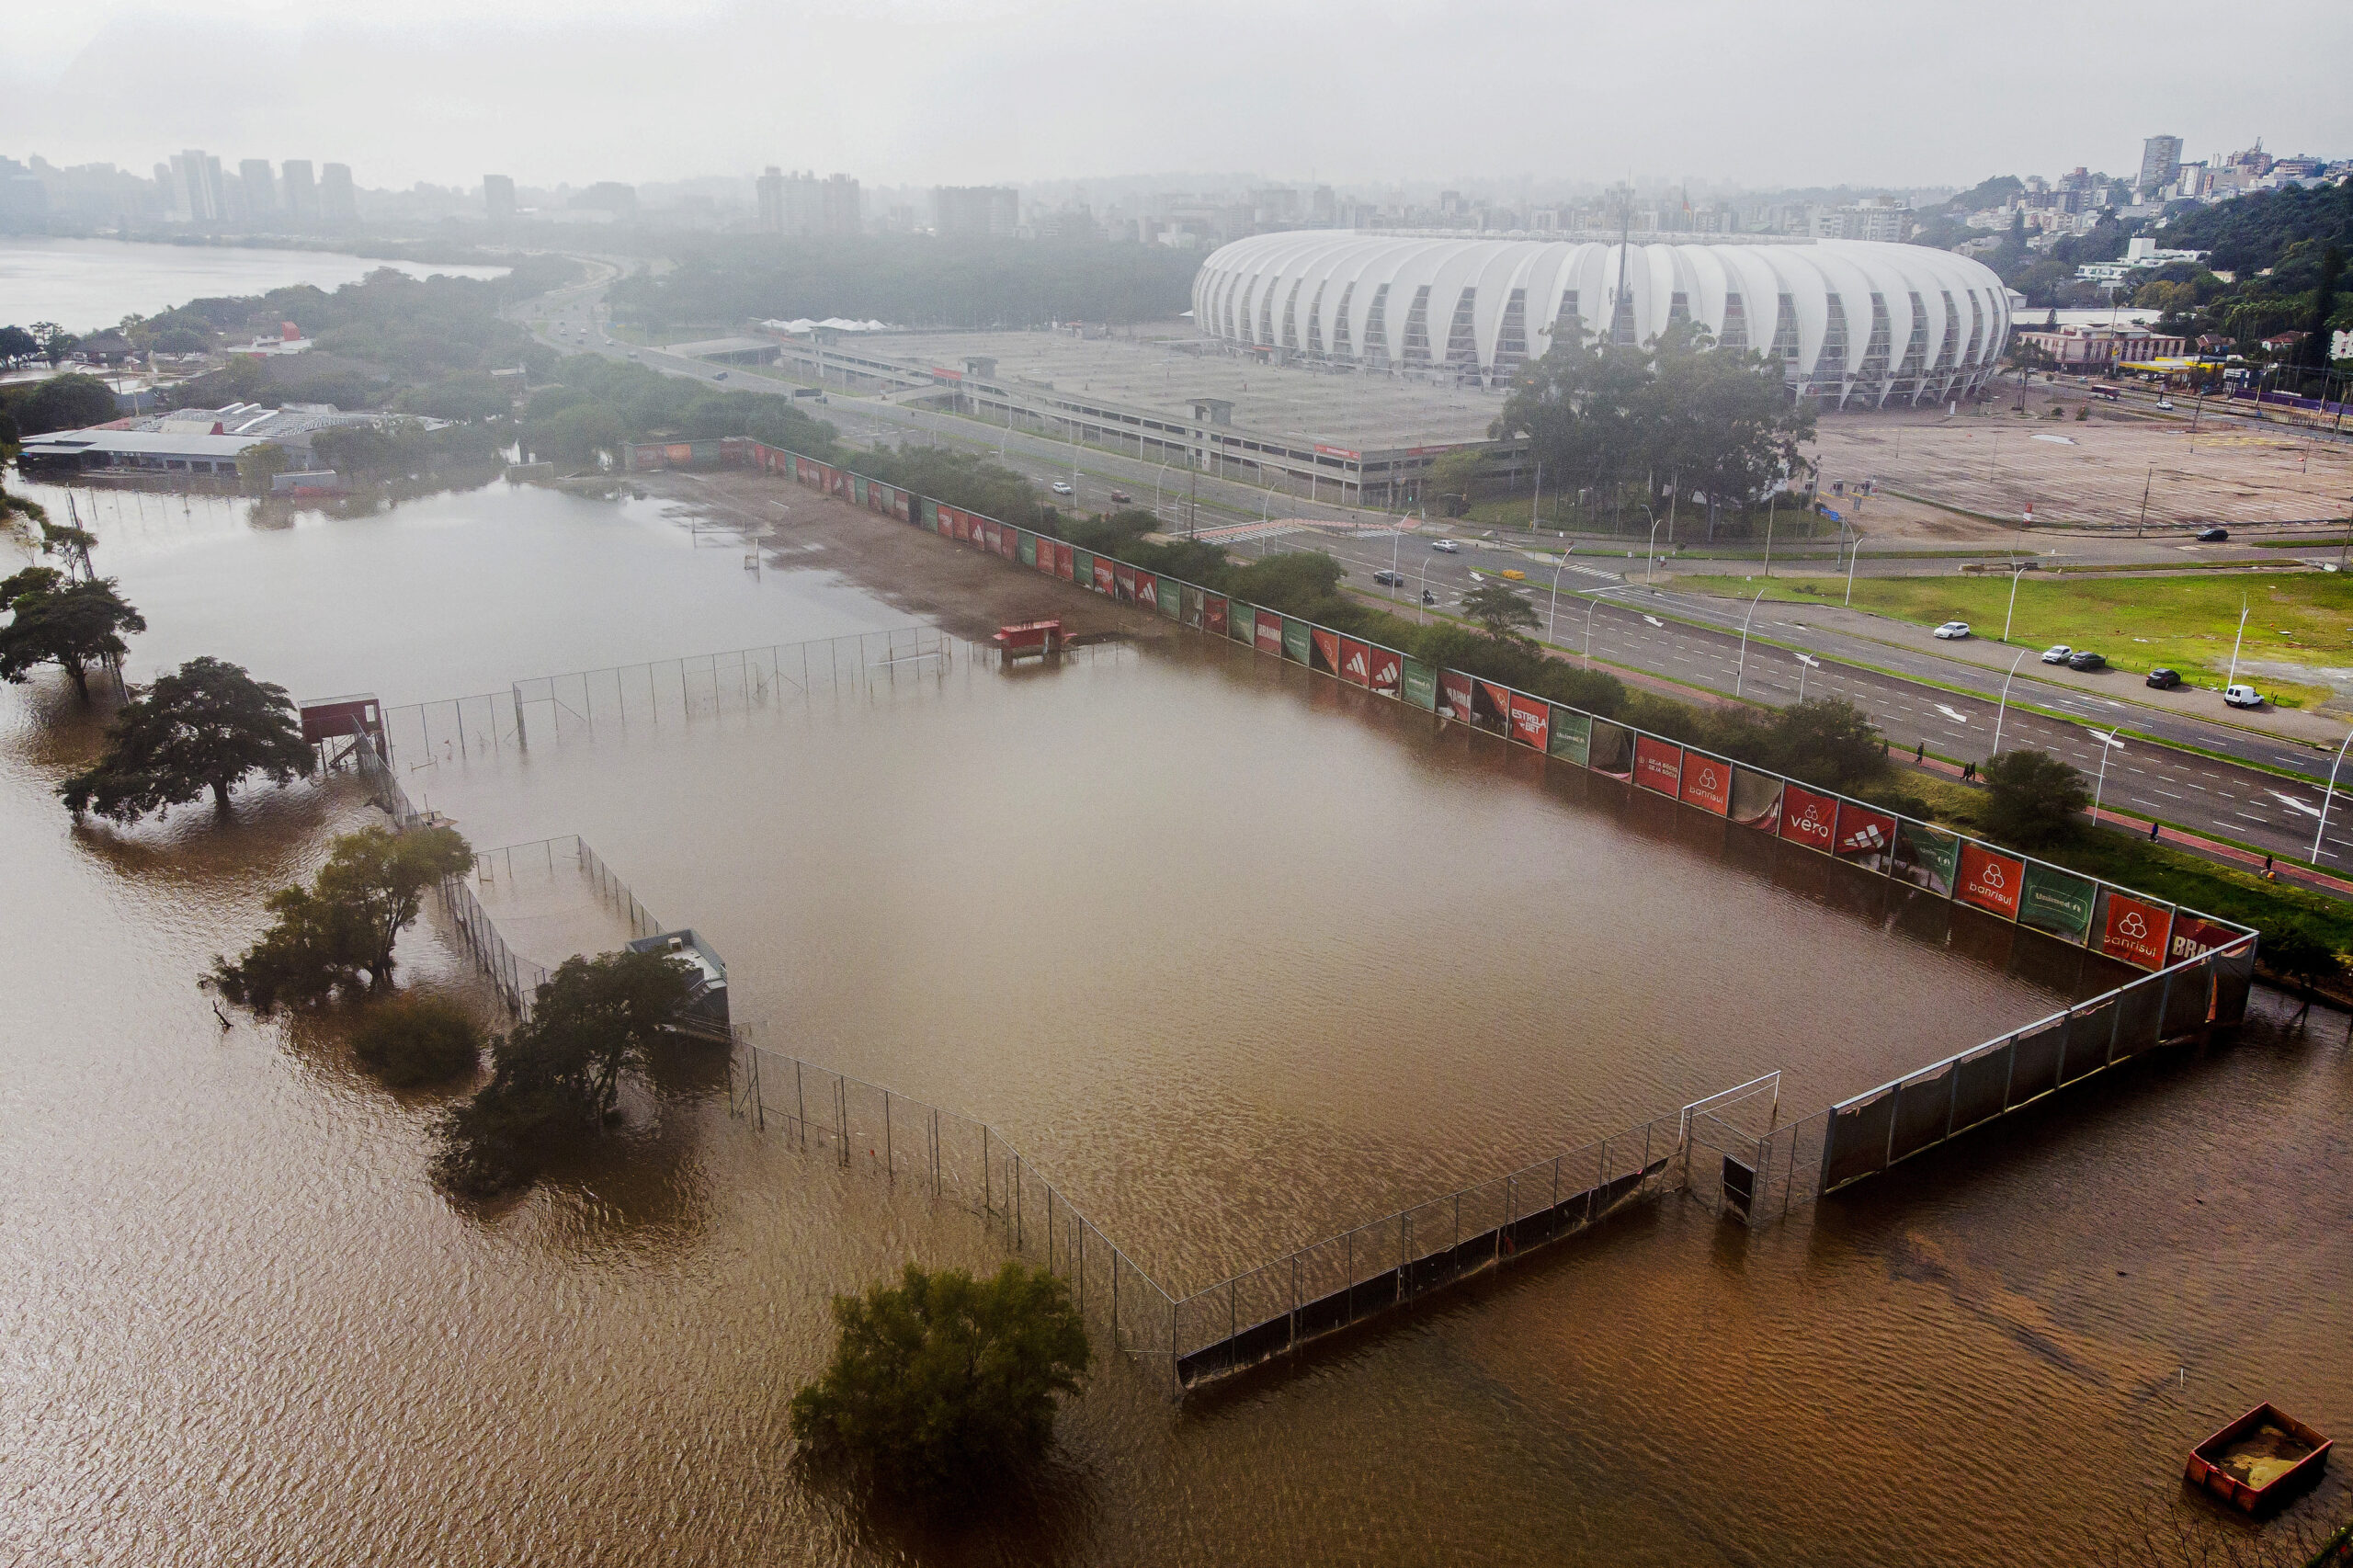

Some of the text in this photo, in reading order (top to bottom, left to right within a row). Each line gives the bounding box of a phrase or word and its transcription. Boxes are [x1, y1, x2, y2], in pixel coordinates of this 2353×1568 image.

[1446, 687, 1471, 710] RAHMA
[1511, 708, 1546, 729] ESTRELA
[1526, 722, 1540, 734] BET
[1688, 784, 1723, 804] banrisul
[1790, 814, 1828, 837] vero
[1969, 881, 2012, 905] banrisul
[2035, 892, 2070, 909] Unimed
